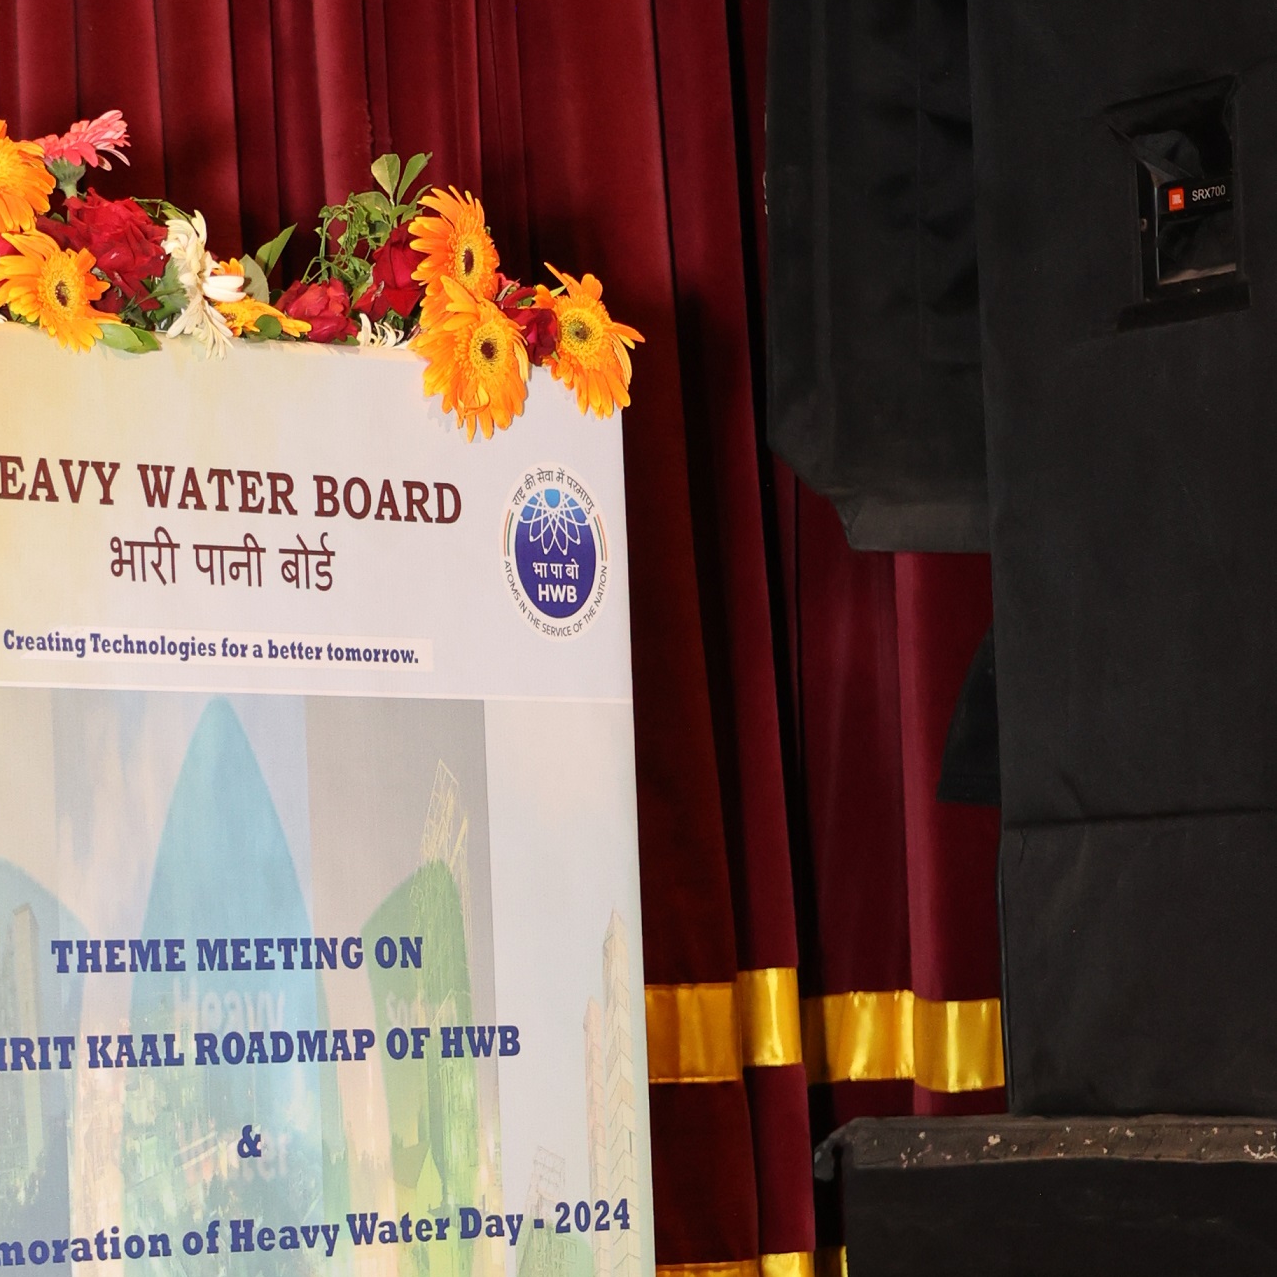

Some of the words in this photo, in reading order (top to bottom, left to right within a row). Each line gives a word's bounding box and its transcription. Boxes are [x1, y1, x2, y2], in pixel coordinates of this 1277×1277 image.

[1192, 184, 1226, 202] SRX700
[136, 463, 298, 516] WATER
[312, 474, 462, 524] BOARD
[525, 474, 536, 489] की
[537, 467, 554, 483] सेवा
[556, 467, 565, 484] में
[566, 475, 595, 515] परमाणु
[109, 525, 181, 586] भारी
[192, 532, 267, 588] पानी
[278, 531, 336, 592] बोर्ड
[532, 562, 548, 579] भा
[549, 563, 563, 579] पा
[565, 558, 579, 580] बो
[504, 560, 521, 602] ATOMS
[519, 600, 528, 614] IN
[527, 611, 541, 629] THE
[542, 623, 572, 637] SERVICE
[573, 619, 583, 633] OF
[583, 605, 597, 624] THE
[594, 565, 608, 608] NATION
[538, 583, 578, 603] HWB
[3, 629, 86, 659] Creating
[89, 633, 217, 662] Technologies
[221, 637, 248, 658] for
[252, 644, 264, 659] a
[267, 639, 323, 661] better
[326, 643, 420, 664] tomorrow.
[50, 938, 186, 974] THEME
[196, 936, 364, 972] MEETING
[374, 935, 423, 970] ON
[86, 1033, 185, 1069] KAAL
[194, 1028, 375, 1066] ROADMAP
[386, 1027, 431, 1061] OF
[440, 1025, 521, 1059] HWB
[237, 1124, 262, 1159] &
[182, 1219, 220, 1256] of
[229, 1218, 340, 1257] Heavy
[345, 1212, 451, 1246] Water
[458, 1206, 524, 1247] Day
[533, 1218, 545, 1230] -
[555, 1198, 630, 1234] 2024
